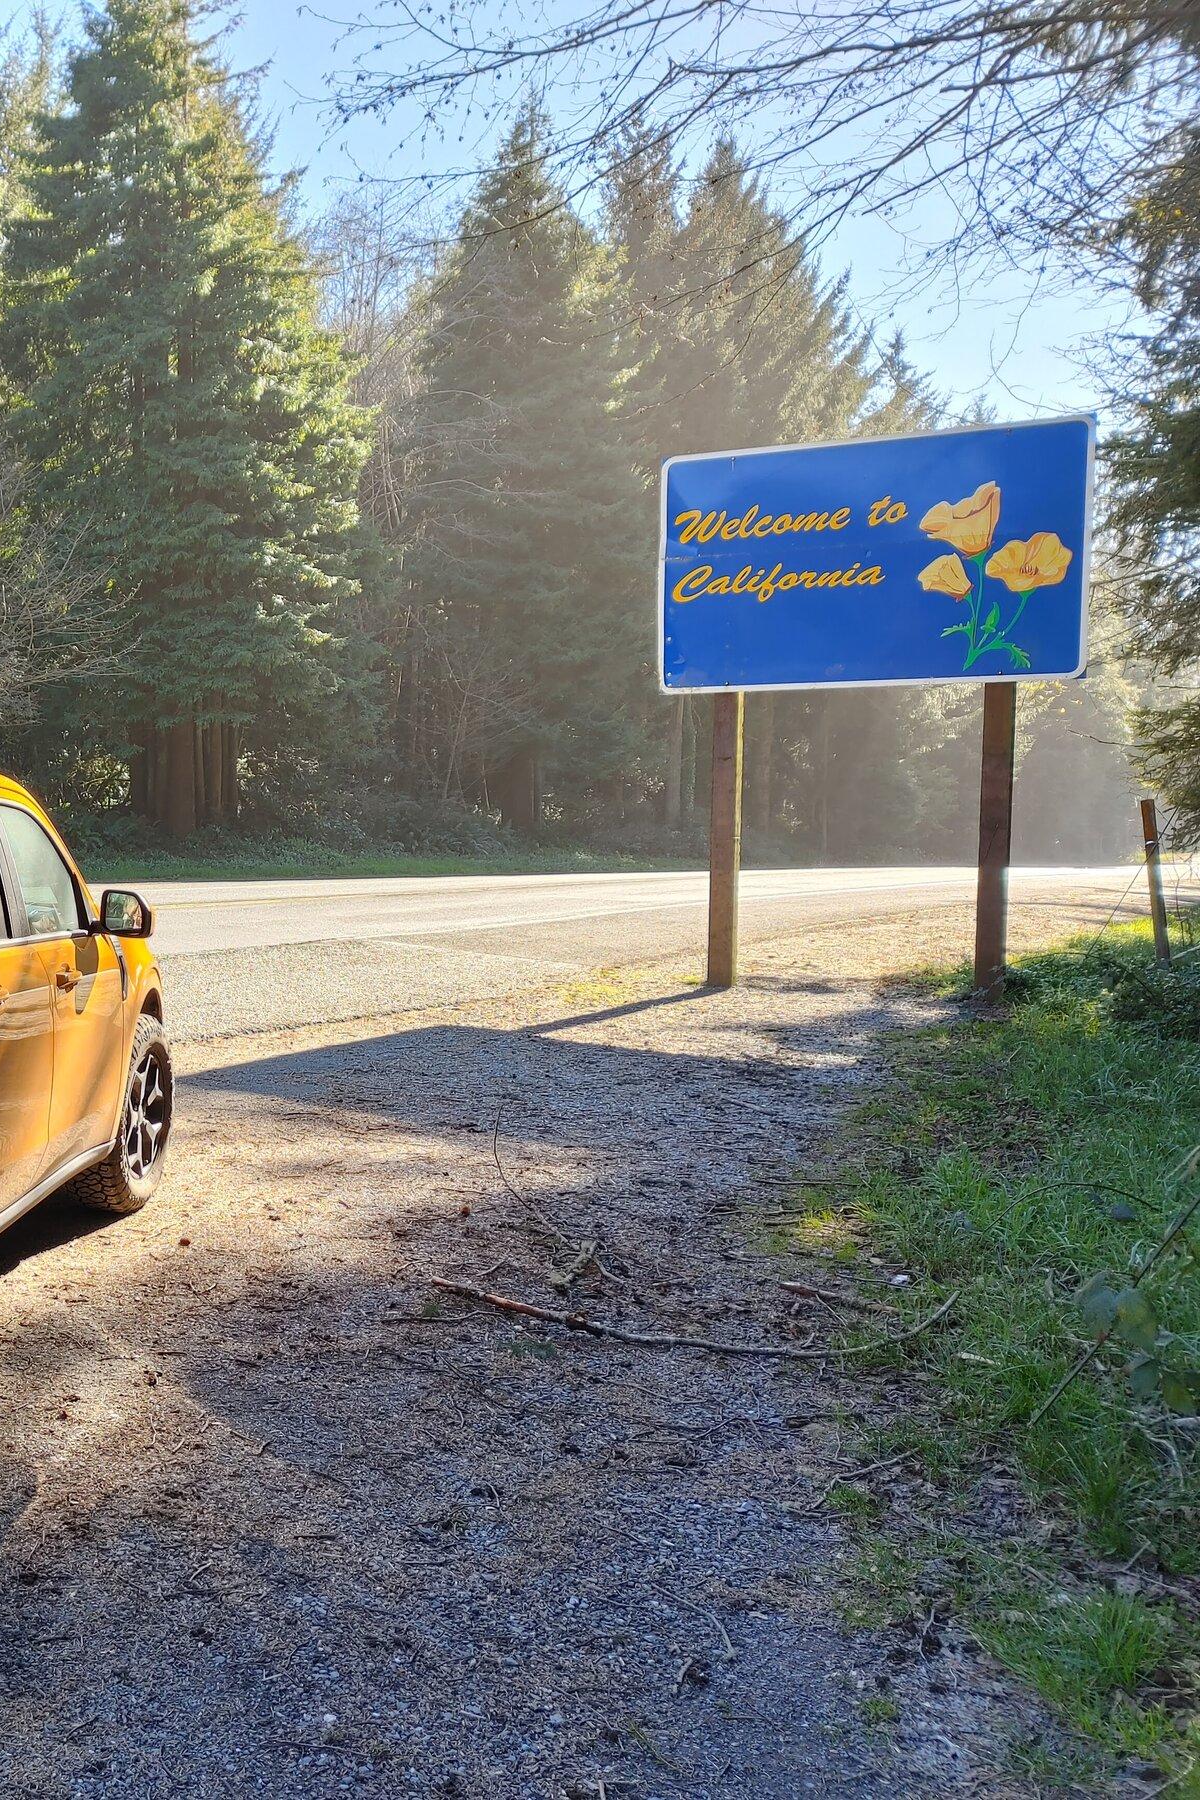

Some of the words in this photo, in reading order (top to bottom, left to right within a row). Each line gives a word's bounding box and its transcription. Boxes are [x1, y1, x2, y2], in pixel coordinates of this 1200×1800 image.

[674, 504, 851, 544] Welcome
[868, 494, 909, 526] to
[672, 561, 886, 603] California
